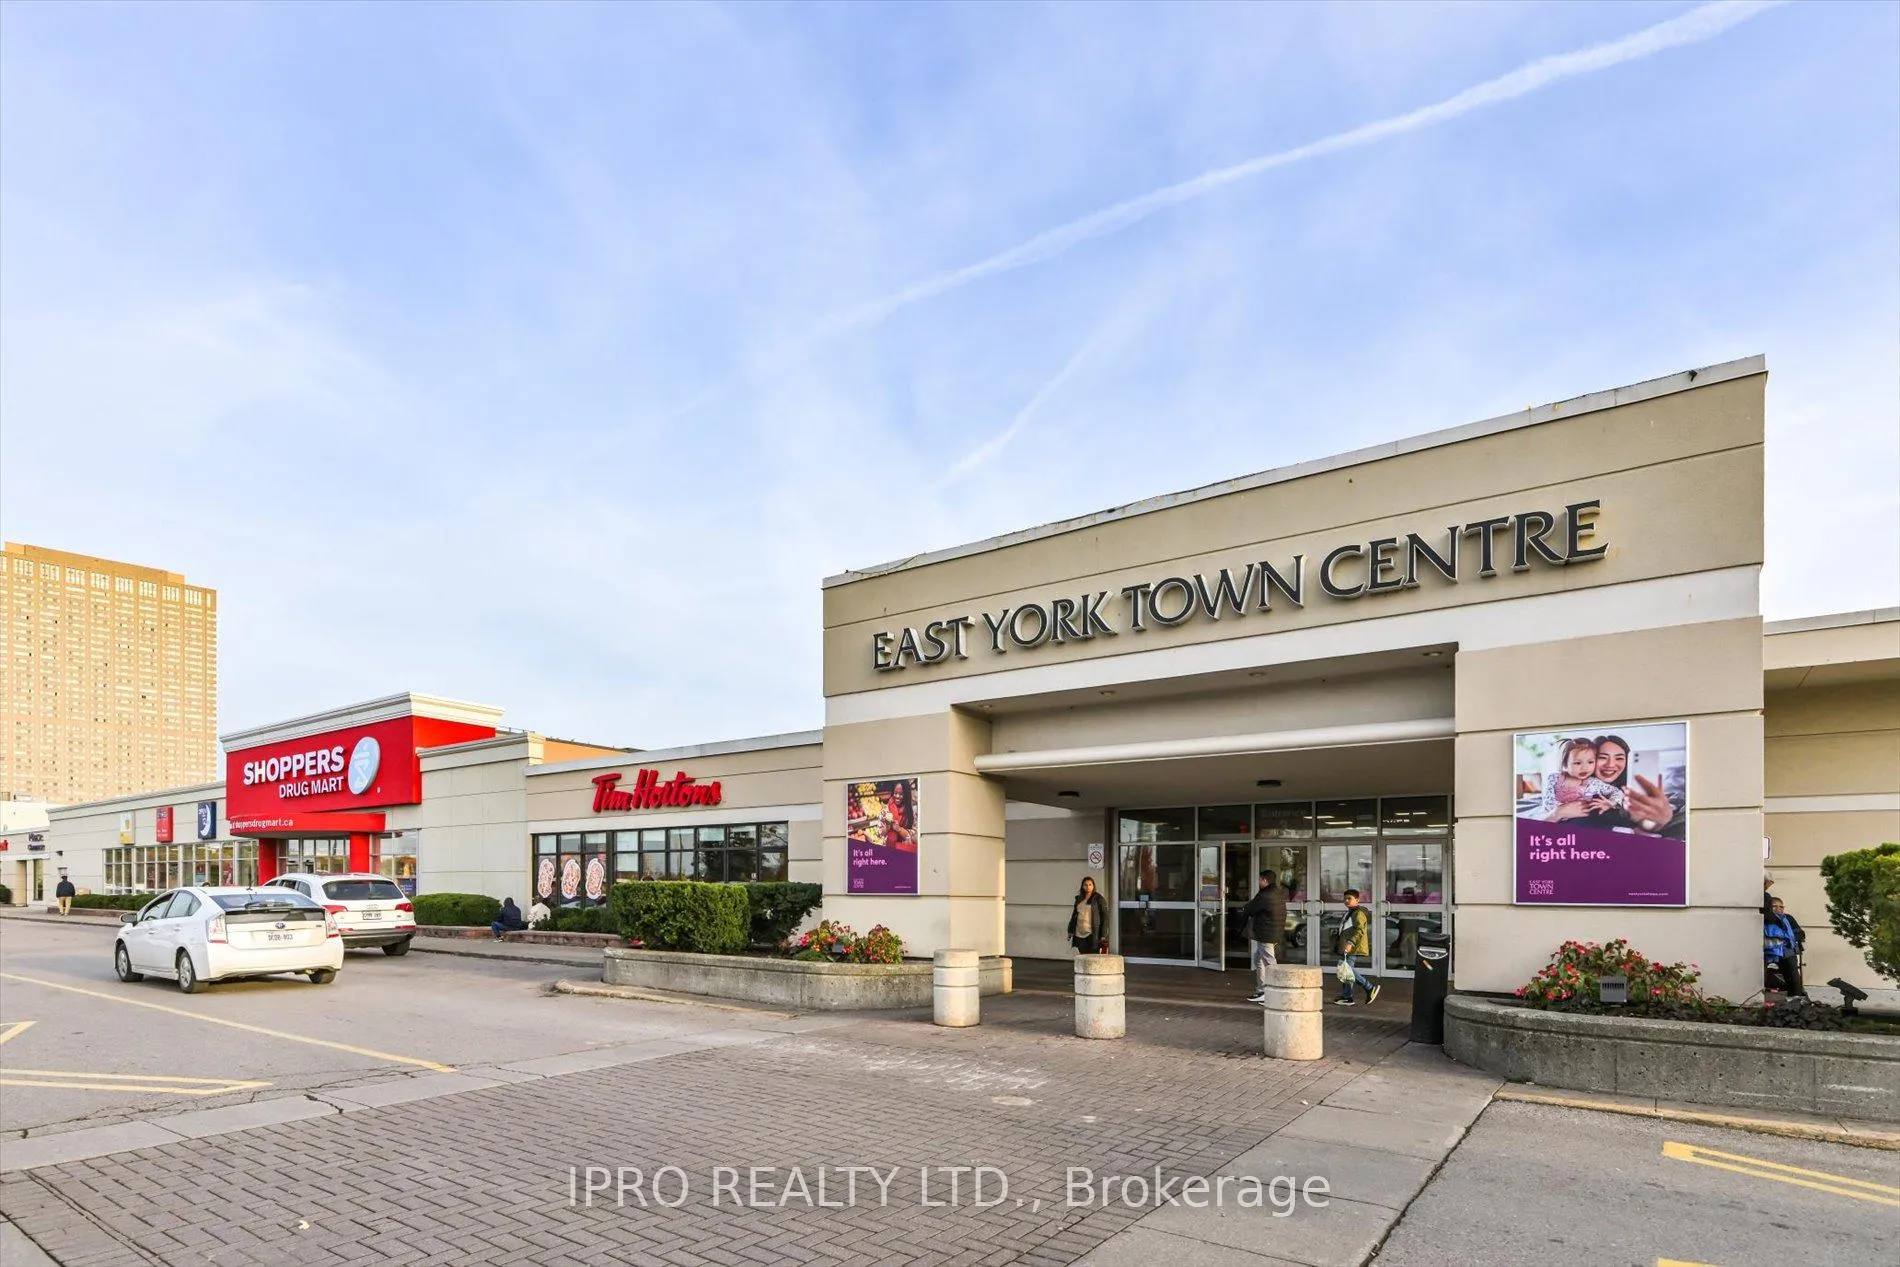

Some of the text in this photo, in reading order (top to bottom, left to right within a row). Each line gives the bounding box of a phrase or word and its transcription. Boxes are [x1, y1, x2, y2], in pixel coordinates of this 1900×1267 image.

[873, 499, 1610, 672] EAST YORK TOWN CENTRE
[243, 745, 345, 786] SHOPPERS
[279, 776, 344, 798] DRUG MART
[592, 768, 722, 813] Tim Hortons
[1529, 834, 1576, 846] It's all
[853, 848, 873, 857] It's all
[1529, 848, 1610, 862] right here.
[853, 857, 887, 867] right here.
